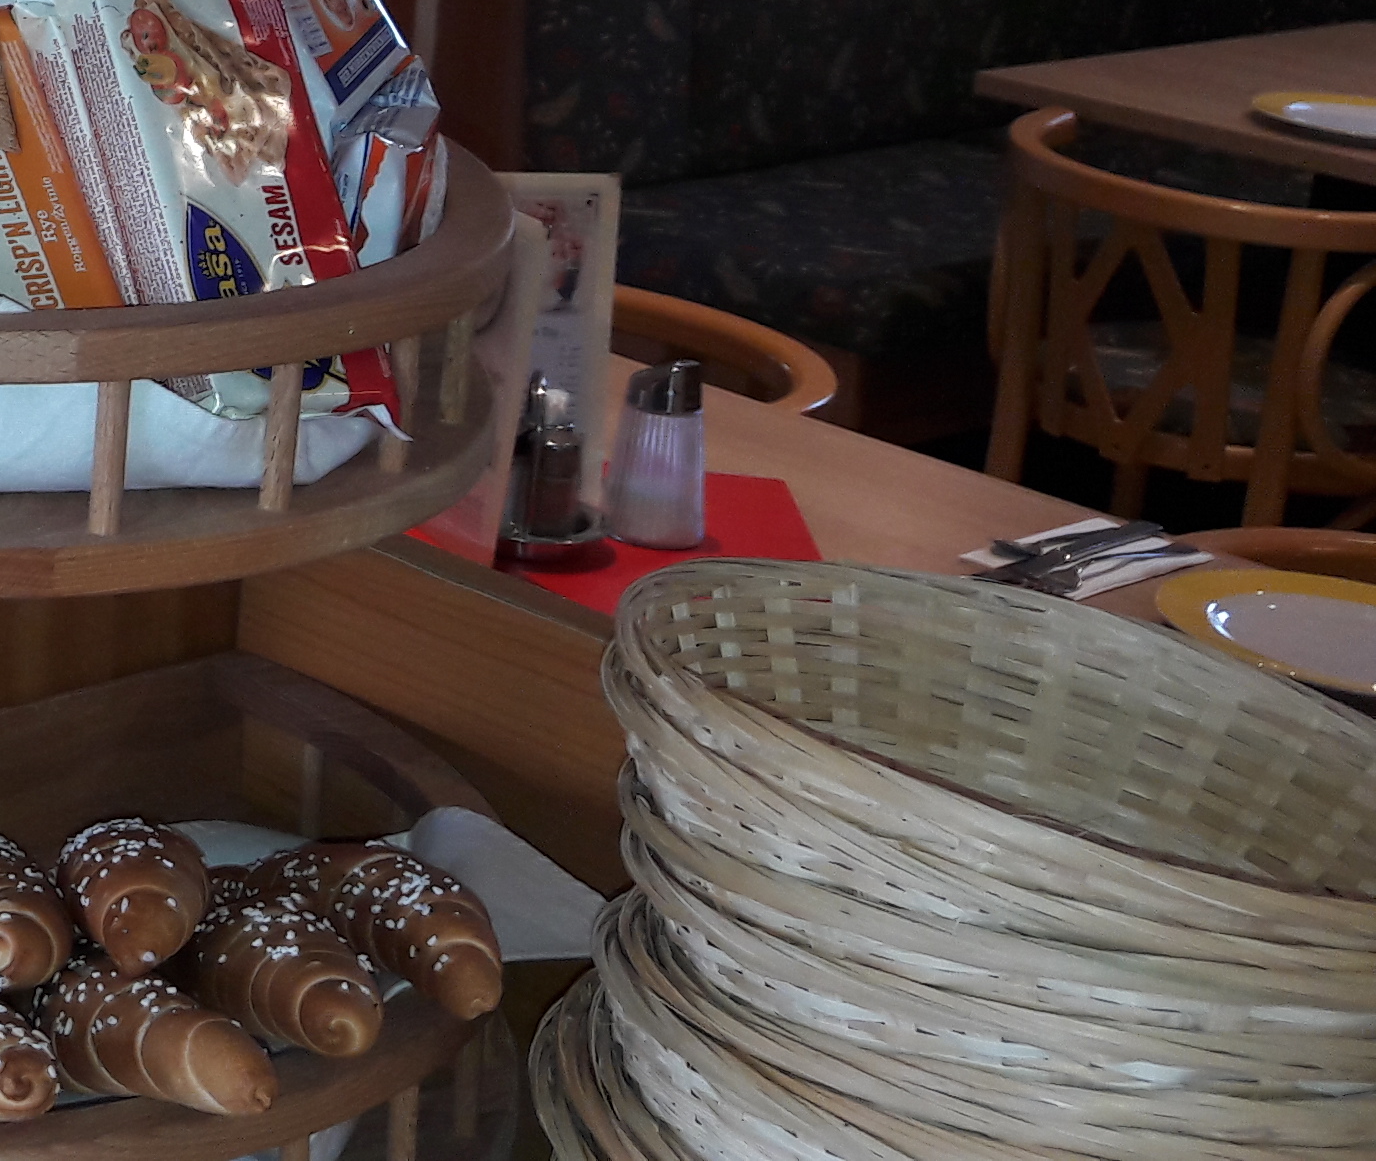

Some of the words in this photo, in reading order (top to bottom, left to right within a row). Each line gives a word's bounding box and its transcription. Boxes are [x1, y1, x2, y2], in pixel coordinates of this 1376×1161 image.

[0, 221, 60, 310] CRISP'N
[36, 209, 58, 243] Rye
[260, 184, 304, 266] SESAM
